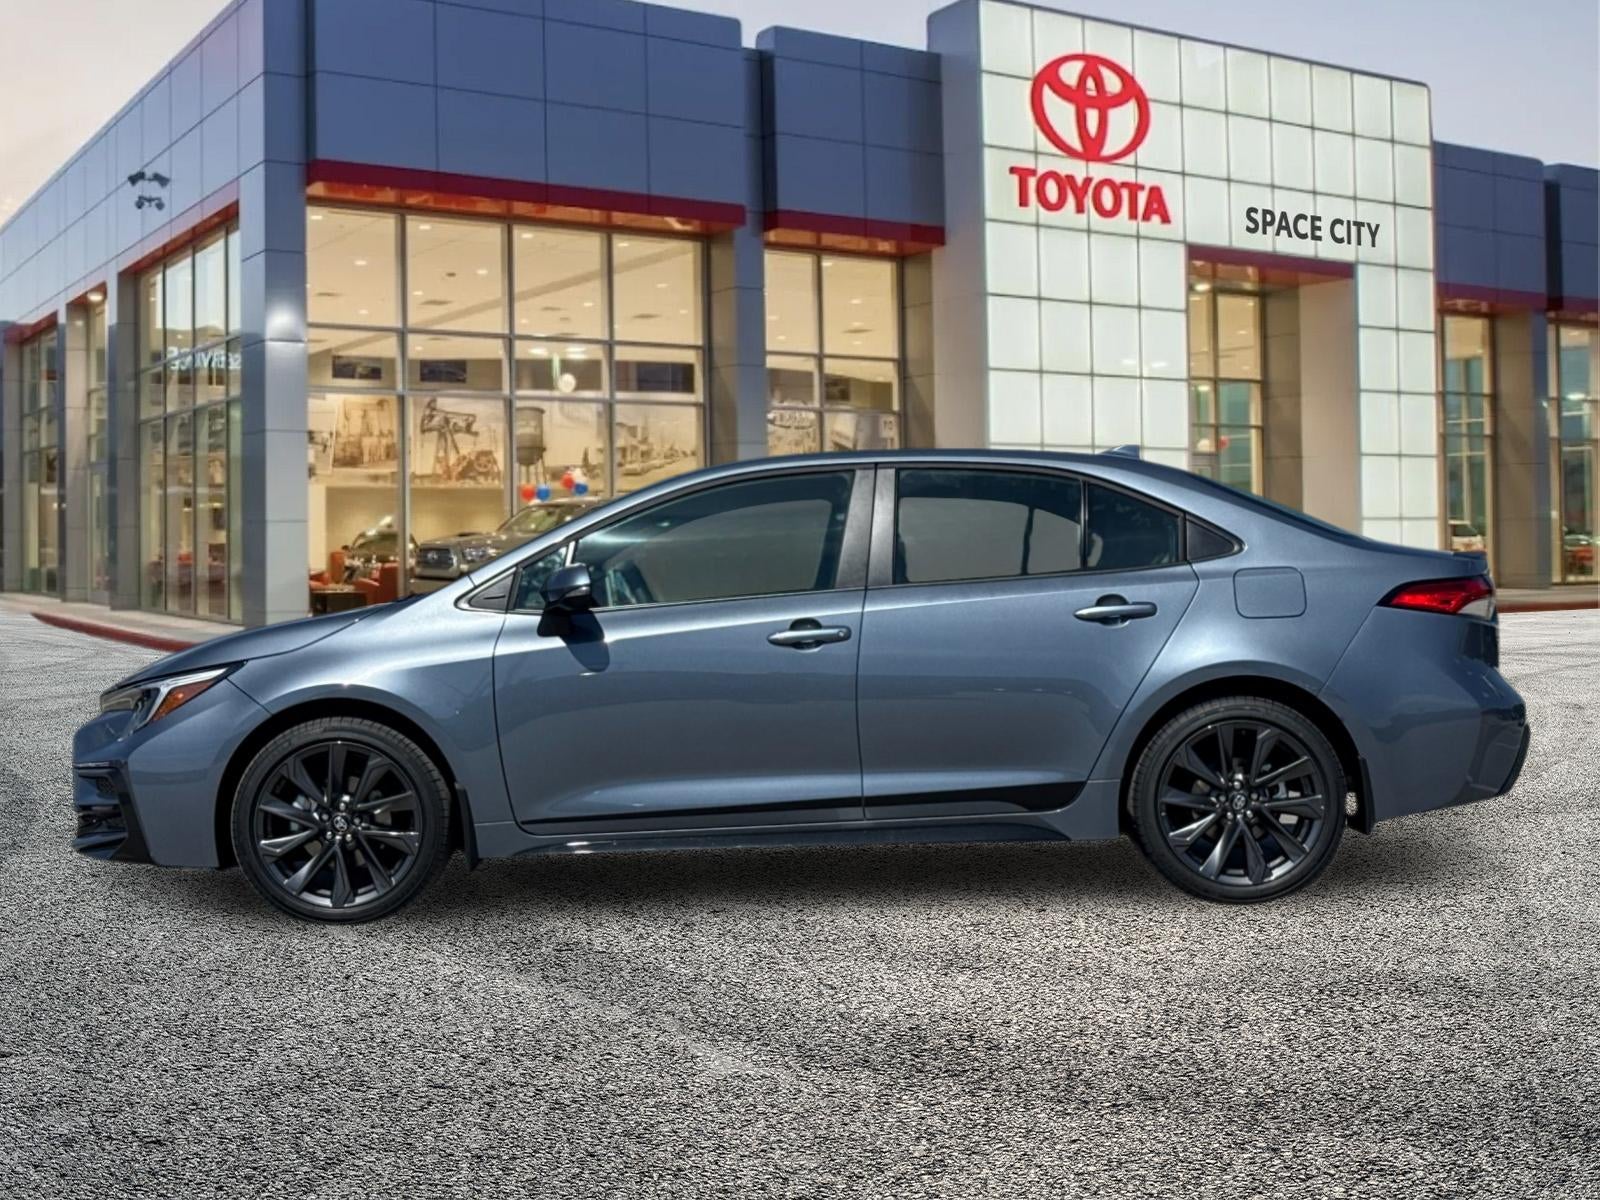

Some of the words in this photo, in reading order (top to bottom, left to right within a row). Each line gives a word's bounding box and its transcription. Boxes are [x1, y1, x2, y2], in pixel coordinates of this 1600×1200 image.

[1009, 166, 1171, 225] TOYOTA
[1245, 206, 1322, 242] SPACE
[1329, 218, 1381, 248] CITY
